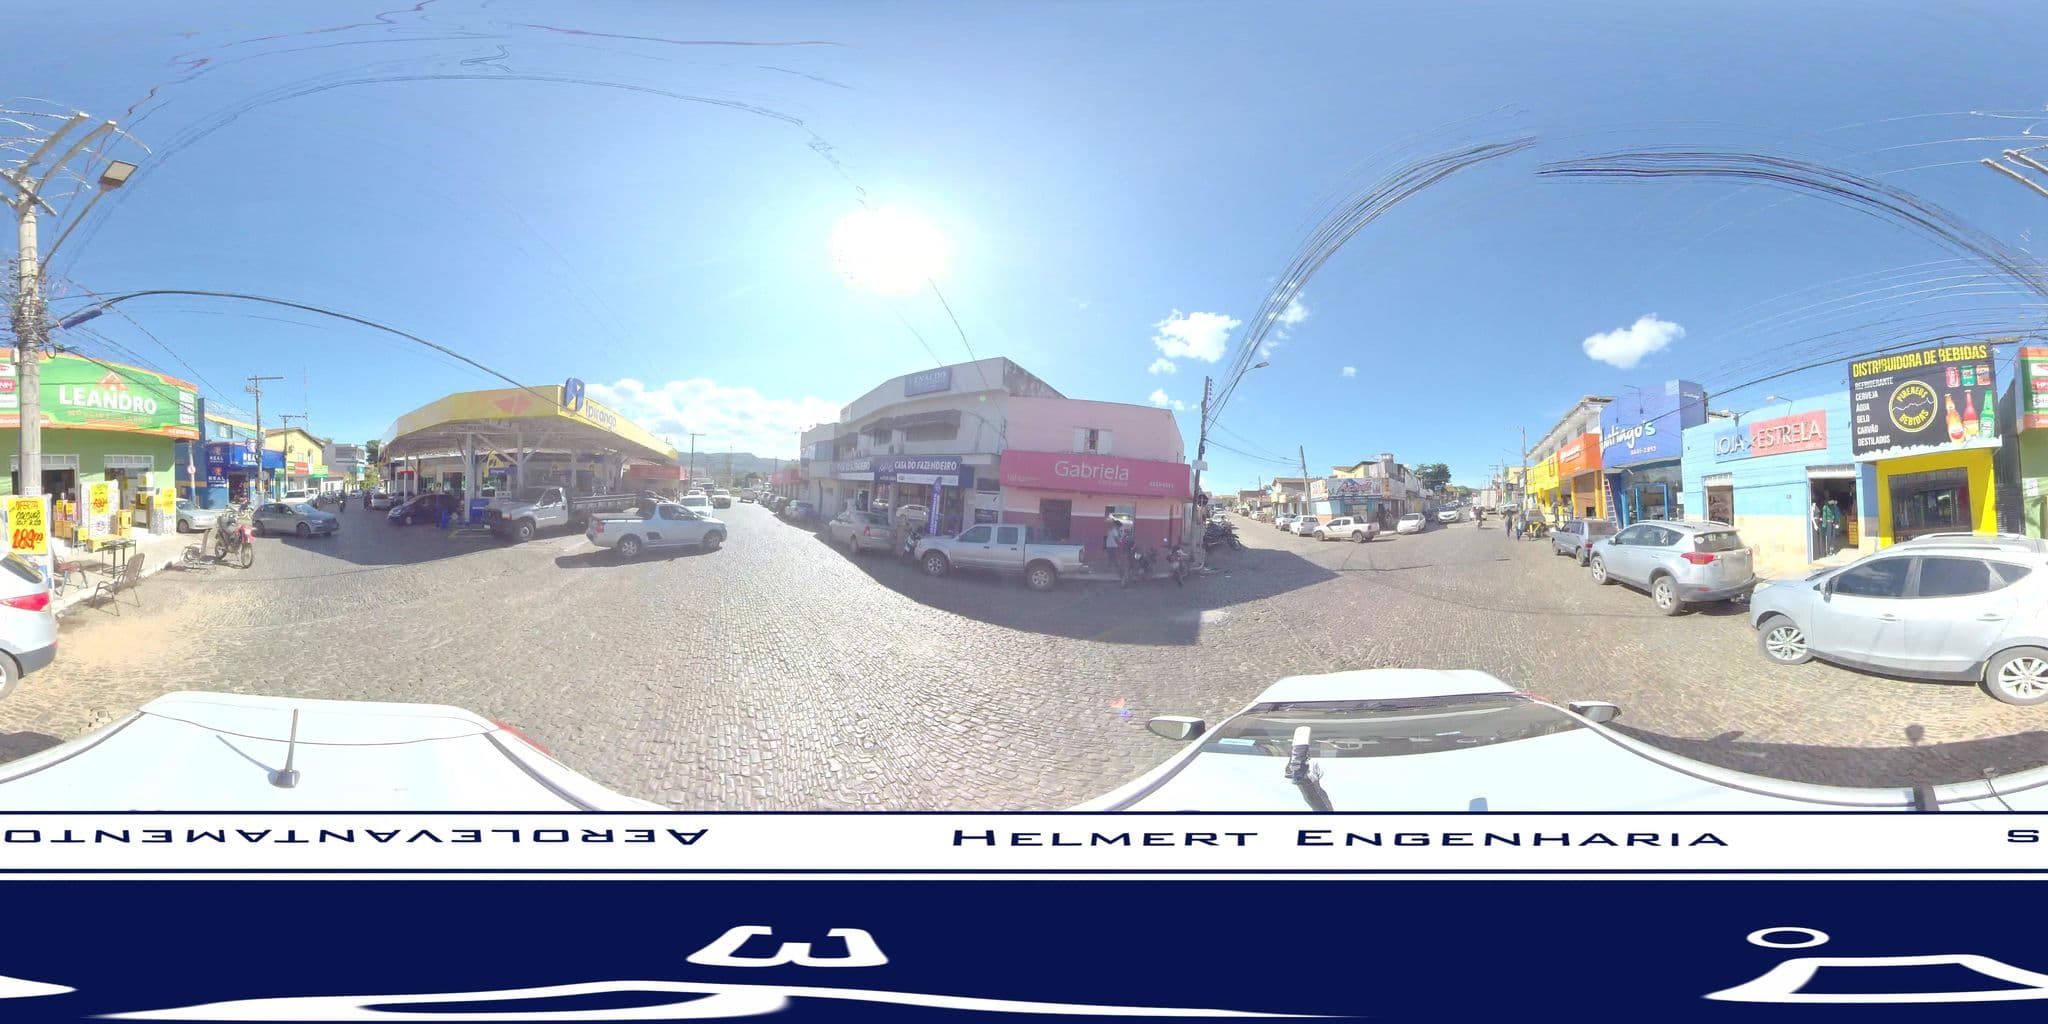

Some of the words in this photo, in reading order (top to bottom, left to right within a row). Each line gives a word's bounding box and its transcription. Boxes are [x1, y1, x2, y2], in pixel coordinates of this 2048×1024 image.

[1852, 352, 1922, 378] DISTRIBUIDORA
[1923, 350, 1937, 364] DE
[1938, 345, 1987, 363] BEBIDAS
[59, 384, 157, 415] LEANDRO
[1855, 390, 1878, 402] CERVEJA
[1896, 385, 1928, 402] PIRENEUS
[1899, 409, 1930, 426] BEBIDAS
[1714, 434, 1746, 456] LOJA
[1757, 420, 1823, 449] ESTRELA
[1054, 460, 1129, 481] Gabriela
